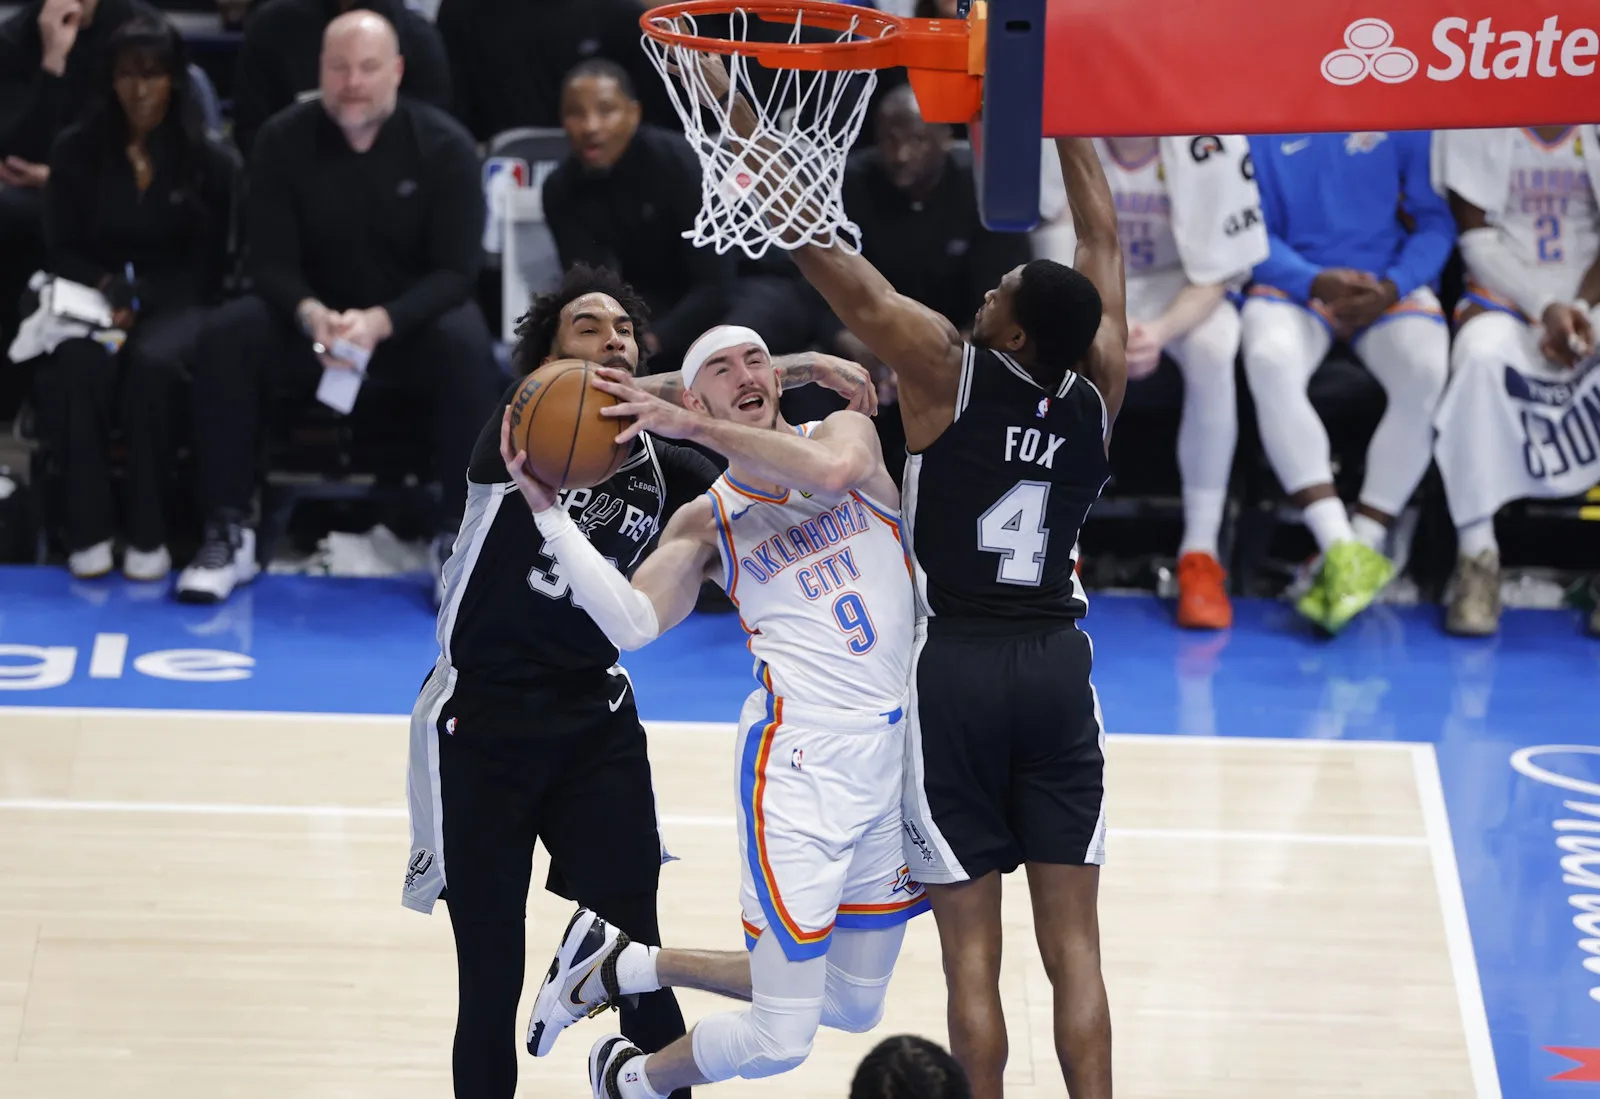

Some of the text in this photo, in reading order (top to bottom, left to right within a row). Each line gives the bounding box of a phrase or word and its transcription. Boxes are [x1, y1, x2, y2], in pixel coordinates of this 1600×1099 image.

[1427, 15, 1599, 81] State
[1535, 213, 1564, 263] 2
[1005, 426, 1066, 469] FOX
[741, 501, 870, 584] OKLAHOMA
[976, 479, 1052, 586] 4
[796, 546, 861, 600] CITY
[831, 591, 878, 656] 9
